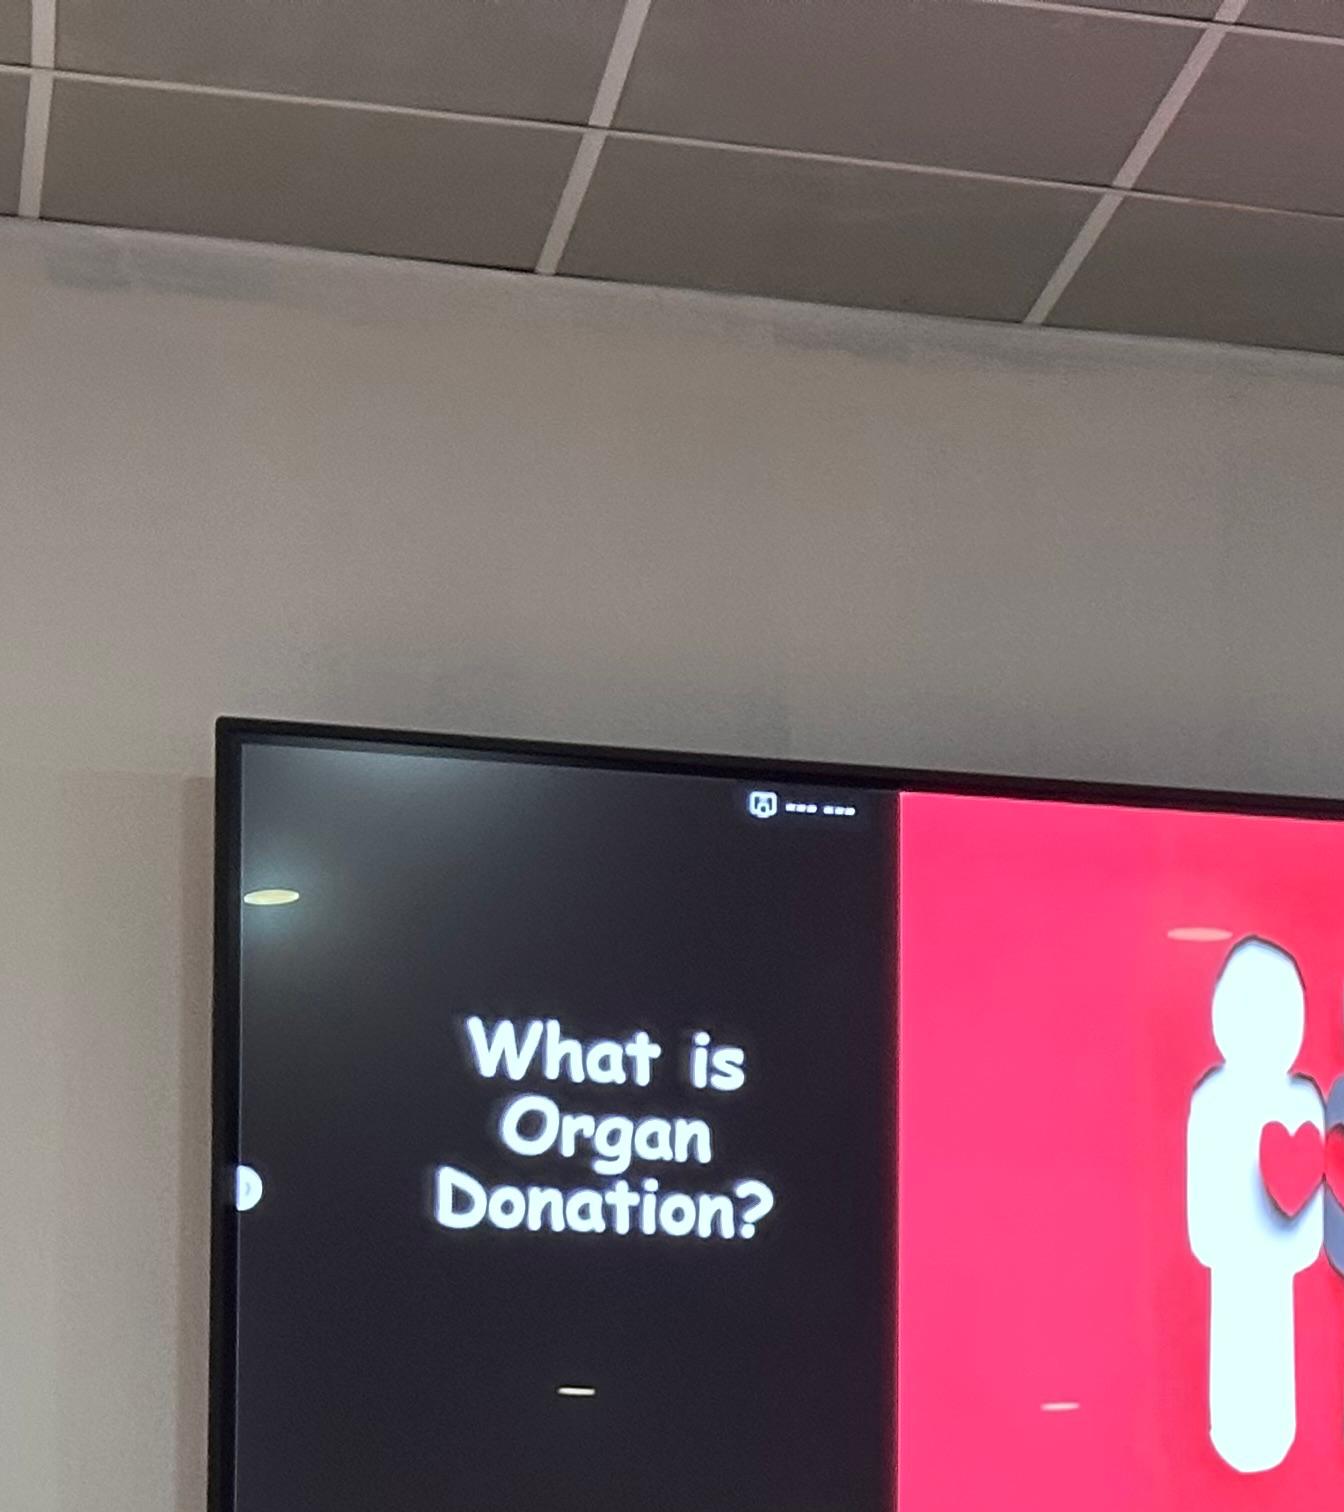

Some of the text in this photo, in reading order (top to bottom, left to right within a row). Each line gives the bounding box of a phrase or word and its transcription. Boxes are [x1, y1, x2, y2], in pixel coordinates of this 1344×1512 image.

[467, 1016, 746, 1091] What is
[500, 1095, 712, 1176] Organ
[435, 1166, 774, 1239] Donation?
